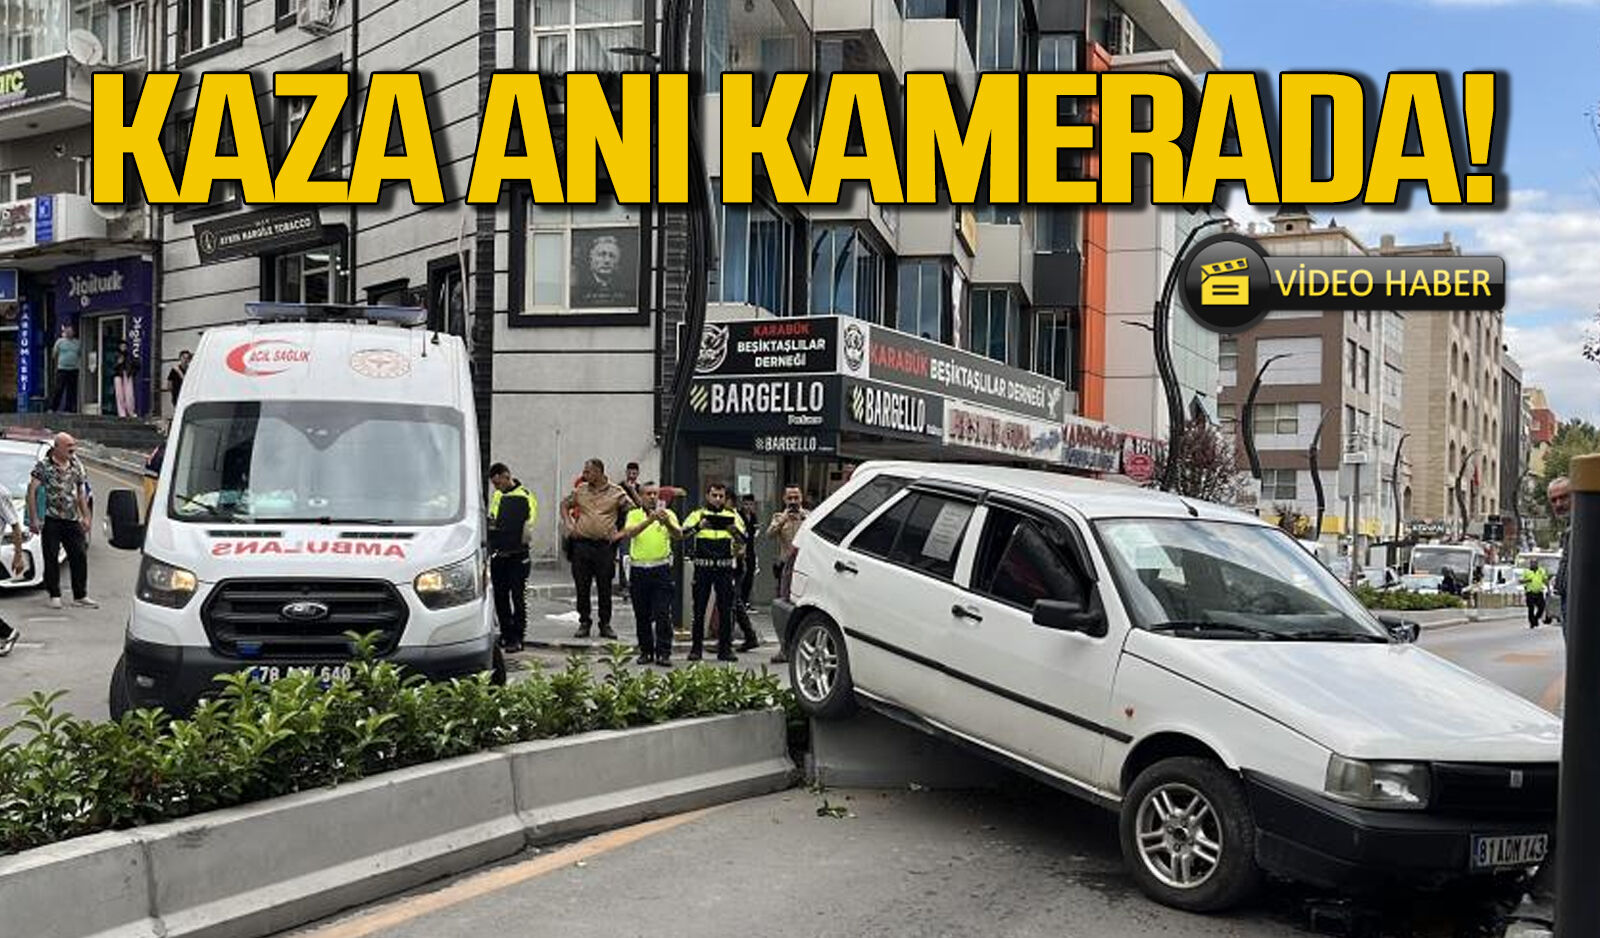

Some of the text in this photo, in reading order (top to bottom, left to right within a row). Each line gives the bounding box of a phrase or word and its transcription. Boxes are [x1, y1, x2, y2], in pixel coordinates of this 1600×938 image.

[274, 217, 312, 234] TOBACCO
[753, 322, 810, 337] KARABÜK
[737, 338, 826, 353] BEŞİKTAŞLILAR
[754, 353, 806, 368] DERNEĞİ
[870, 343, 1045, 408] KARABÜK BEŞİKTAŞLILAR DERNEĞİ
[710, 382, 824, 414] BARGELLO
[865, 387, 926, 433] BARGELLO
[764, 436, 816, 451] BARGELLO
